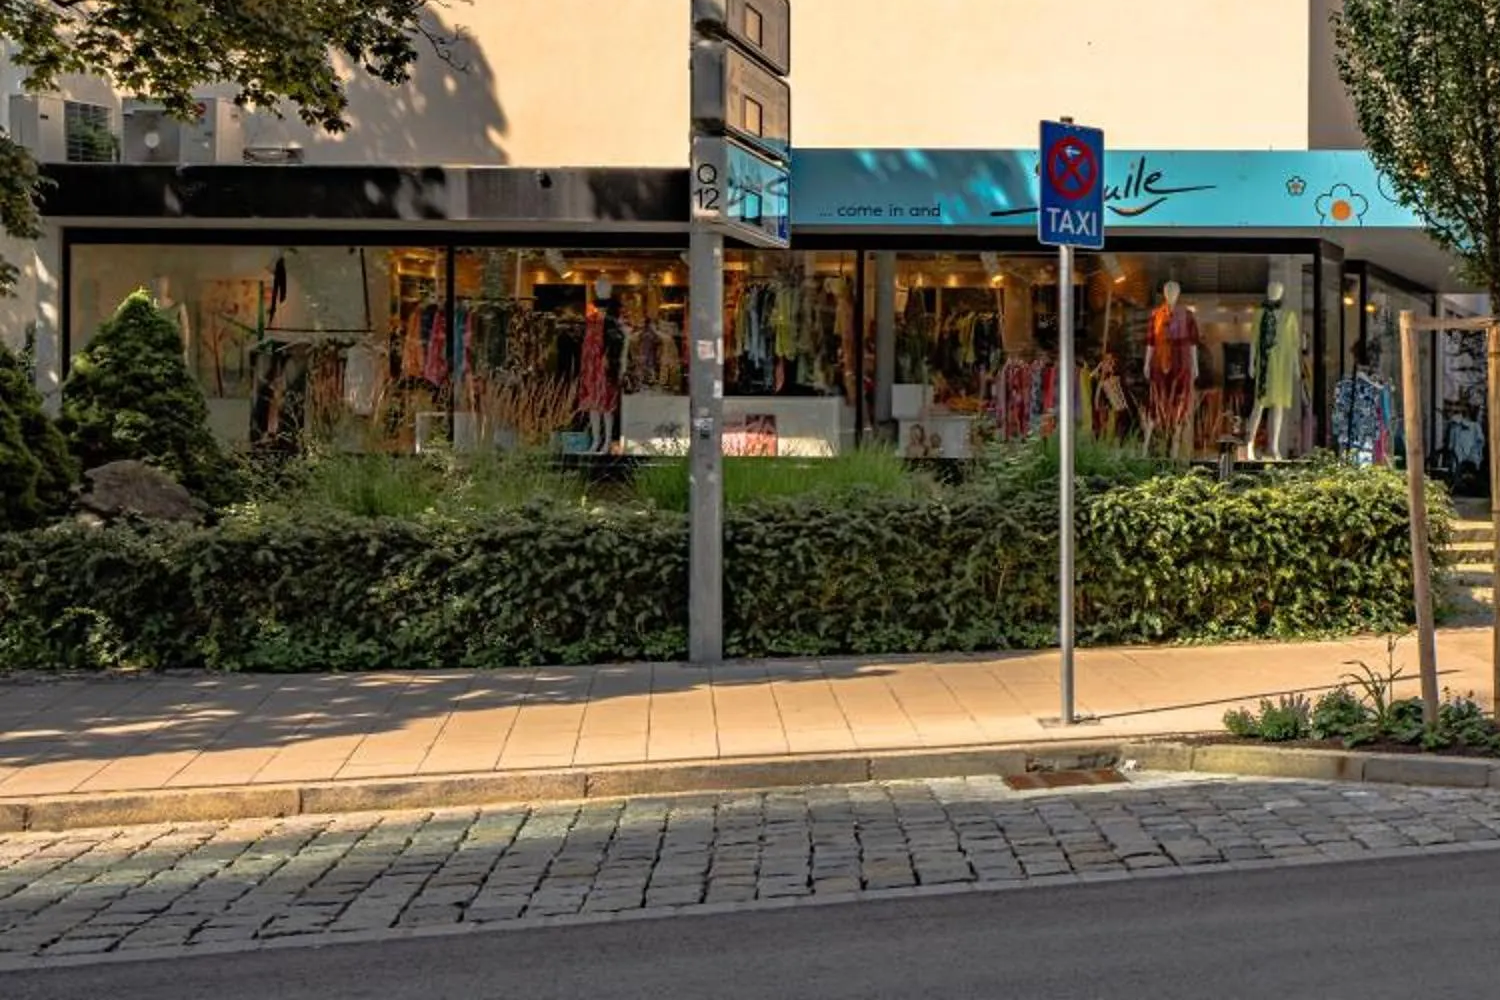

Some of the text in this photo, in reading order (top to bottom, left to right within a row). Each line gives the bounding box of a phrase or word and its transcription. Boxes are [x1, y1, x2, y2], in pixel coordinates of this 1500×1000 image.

[694, 187, 720, 210] 12
[837, 205, 883, 217] come
[888, 203, 904, 217] in
[909, 203, 942, 217] and
[1046, 206, 1098, 237] TAXI
